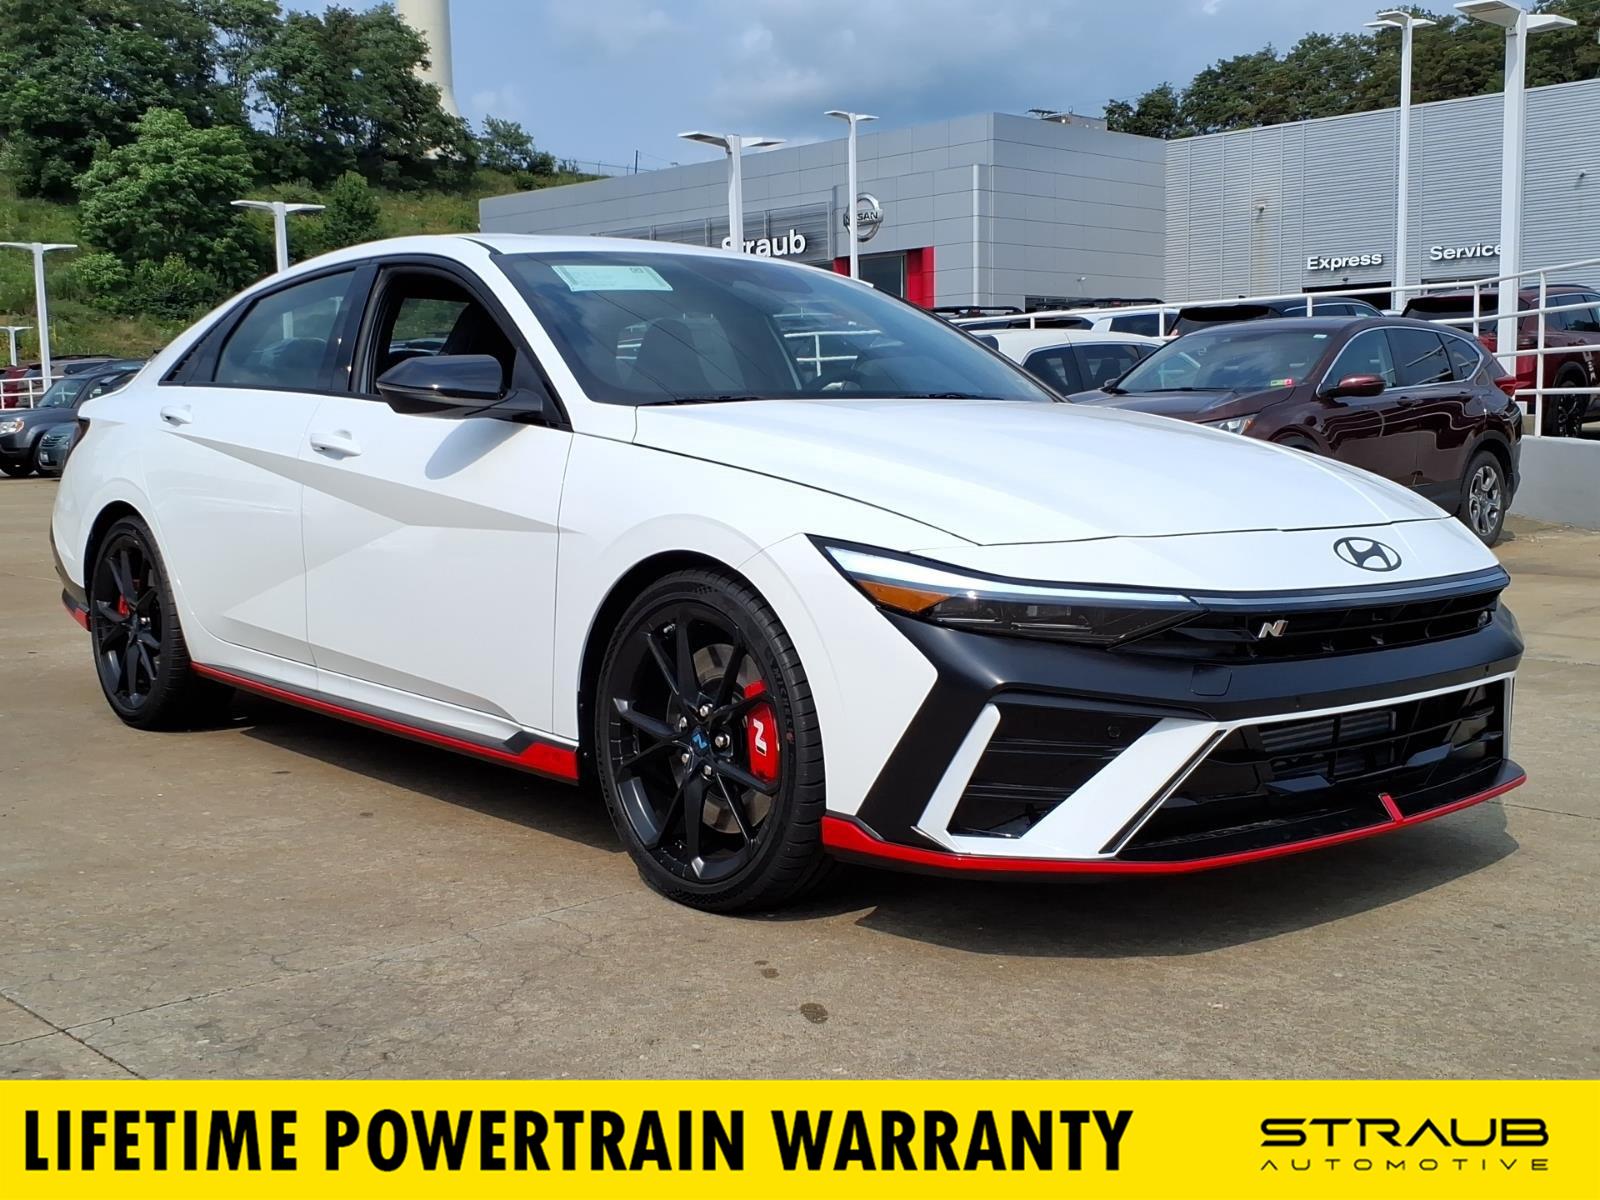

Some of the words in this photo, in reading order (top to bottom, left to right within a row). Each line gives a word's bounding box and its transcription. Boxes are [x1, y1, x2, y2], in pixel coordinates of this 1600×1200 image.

[845, 211, 878, 225] NSAN
[722, 229, 806, 256] raub
[1307, 254, 1382, 271] Express
